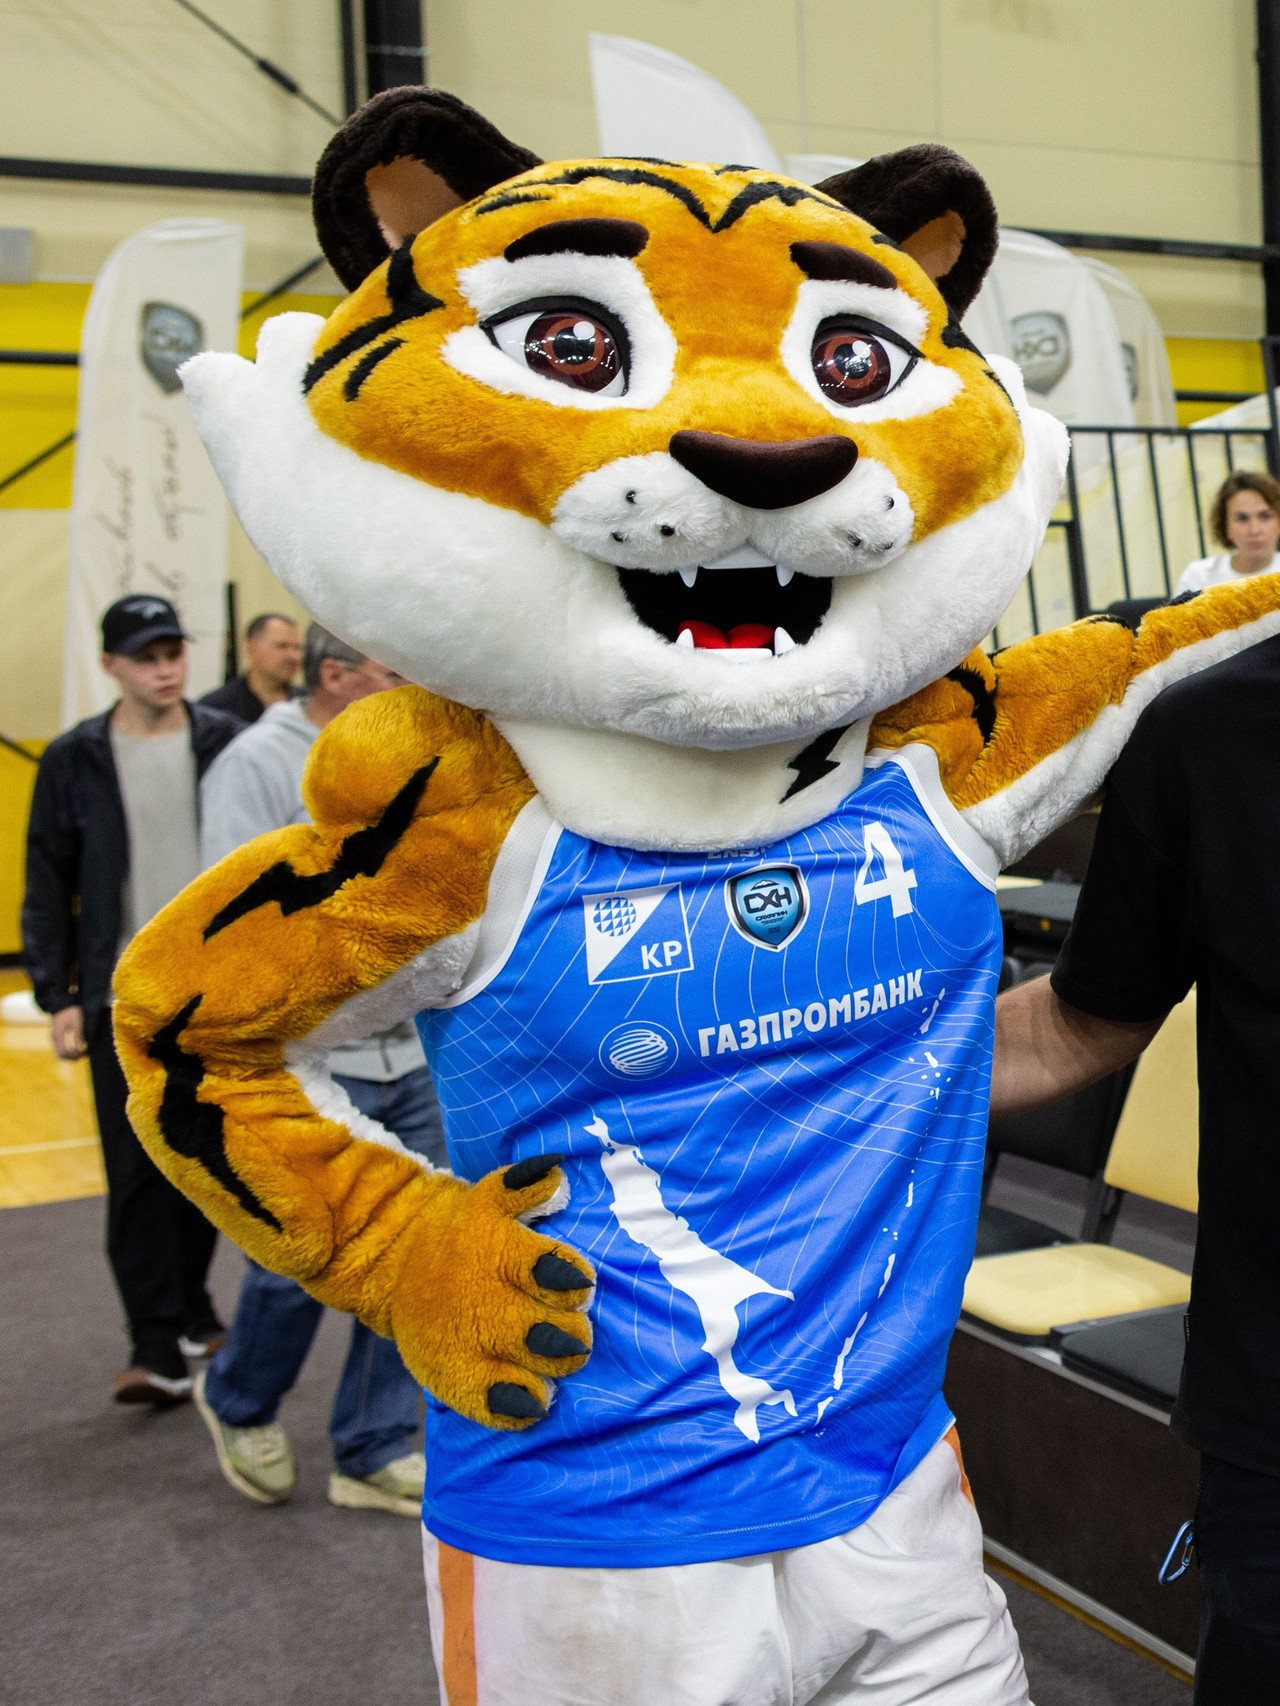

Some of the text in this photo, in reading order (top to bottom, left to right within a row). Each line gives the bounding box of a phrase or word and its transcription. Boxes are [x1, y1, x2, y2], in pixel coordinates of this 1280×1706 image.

[856, 821, 918, 918] 4
[641, 940, 682, 970] КР
[698, 968, 923, 1057] ГАЗПРОМБАНК
